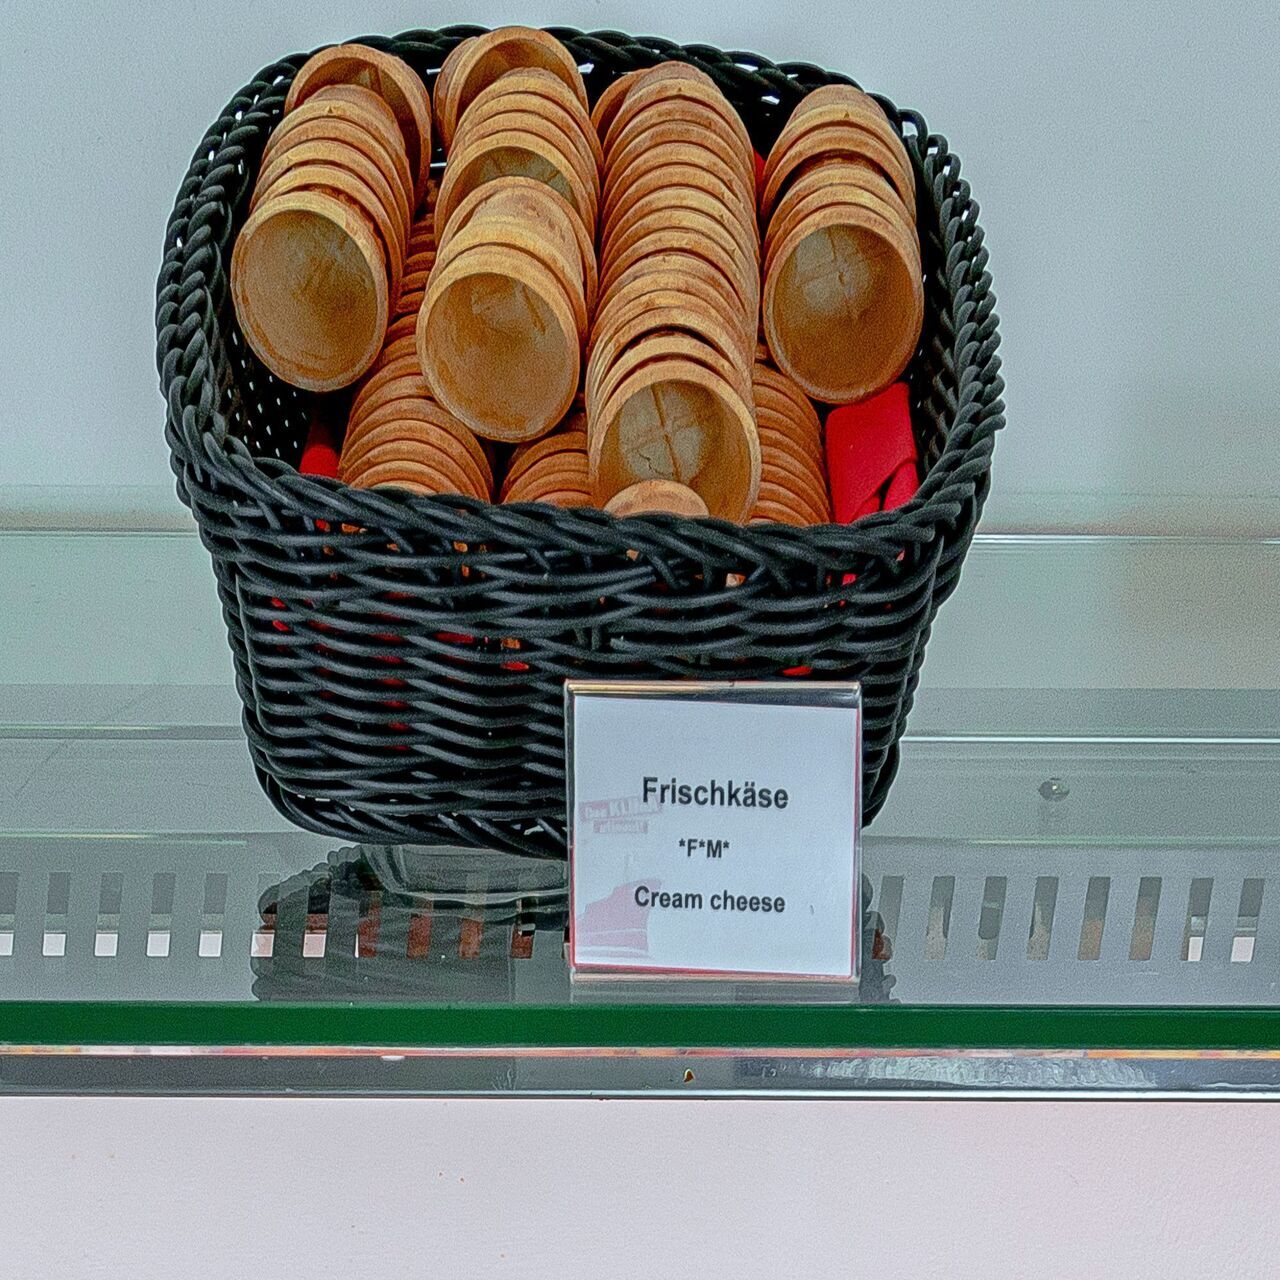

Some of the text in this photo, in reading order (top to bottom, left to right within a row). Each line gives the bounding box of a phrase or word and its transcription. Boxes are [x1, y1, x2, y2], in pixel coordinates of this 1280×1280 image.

[643, 777, 788, 809] Frischkäse
[635, 886, 785, 912] Cream cheese
